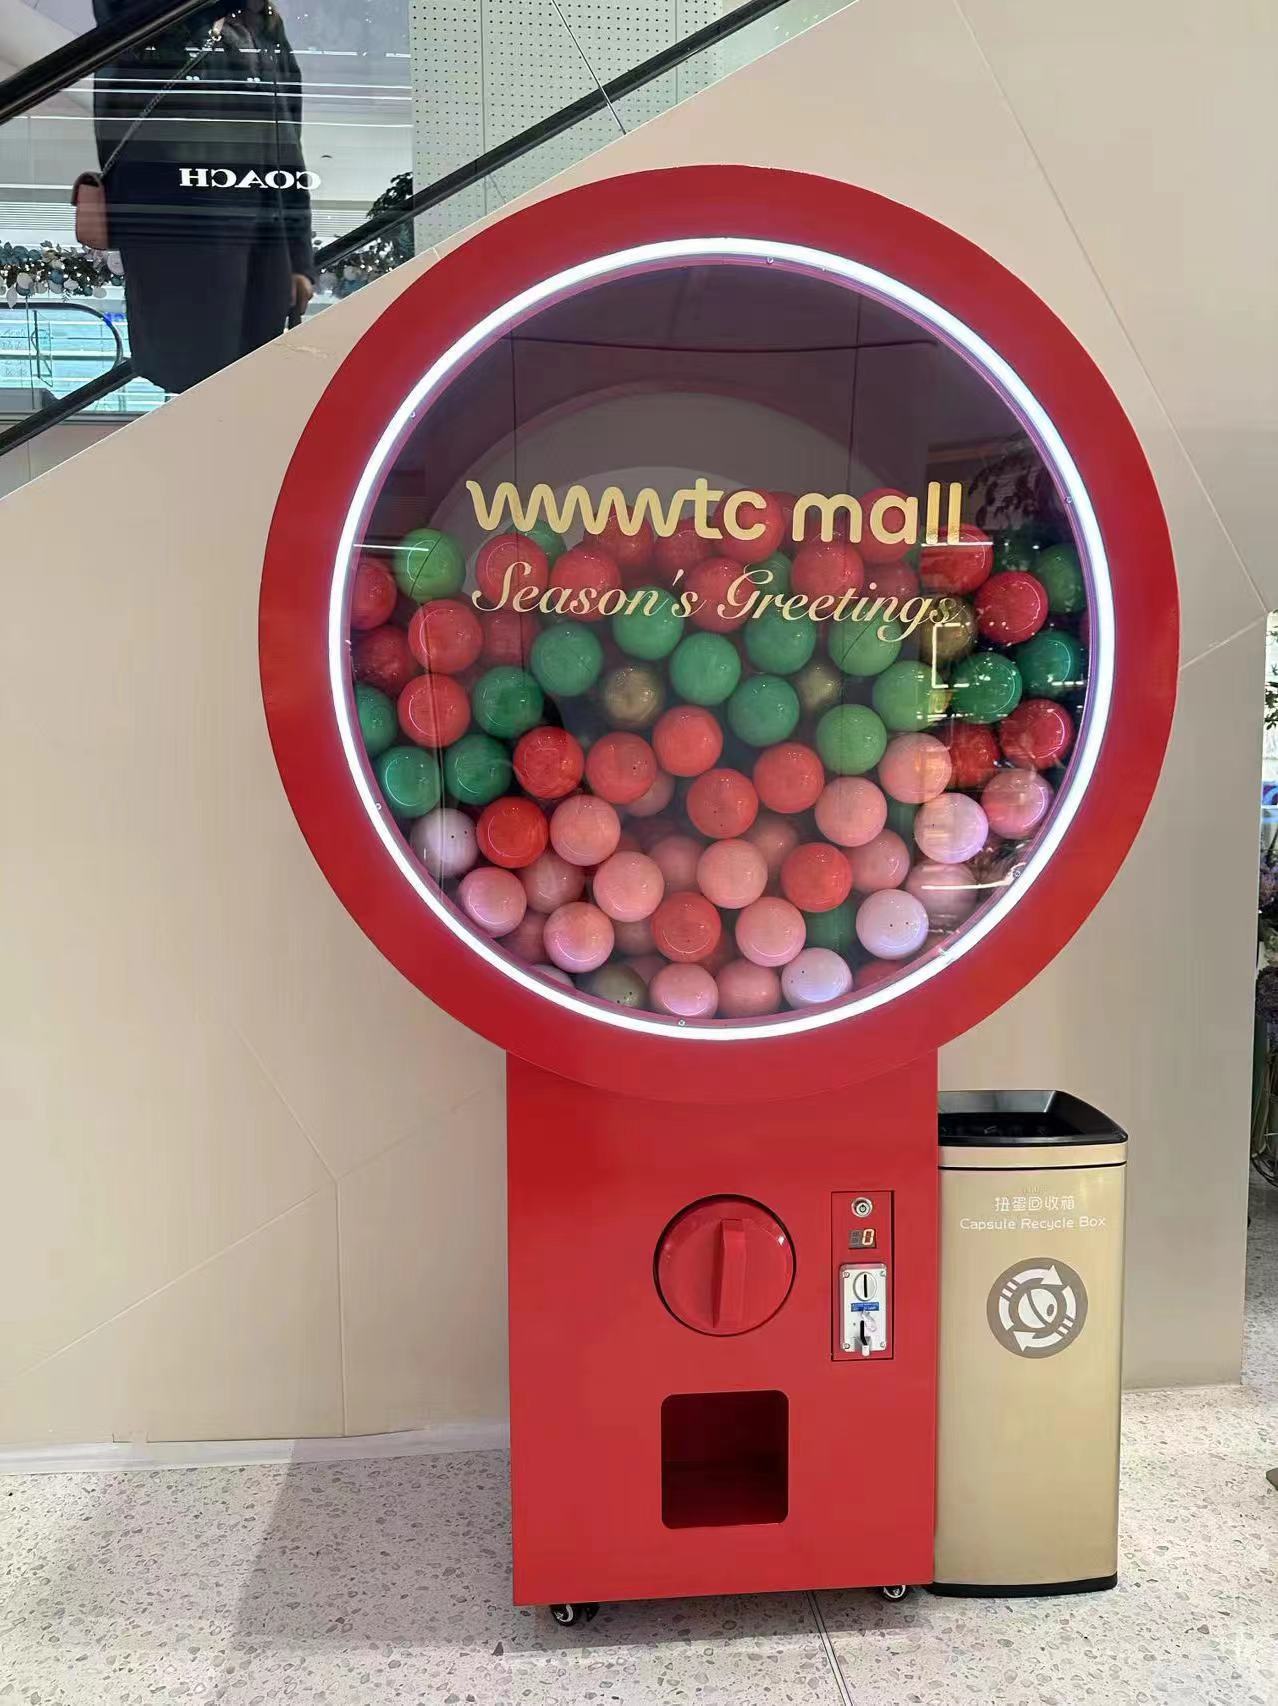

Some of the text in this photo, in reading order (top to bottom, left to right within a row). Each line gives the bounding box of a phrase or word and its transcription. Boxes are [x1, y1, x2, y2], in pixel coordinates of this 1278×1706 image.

[792, 481, 962, 545] mall
[471, 561, 961, 643] Season's Greetings
[960, 1216, 1107, 1231] Capsule Recycle Box
[994, 1196, 1075, 1212] 扭蛋回收箱
